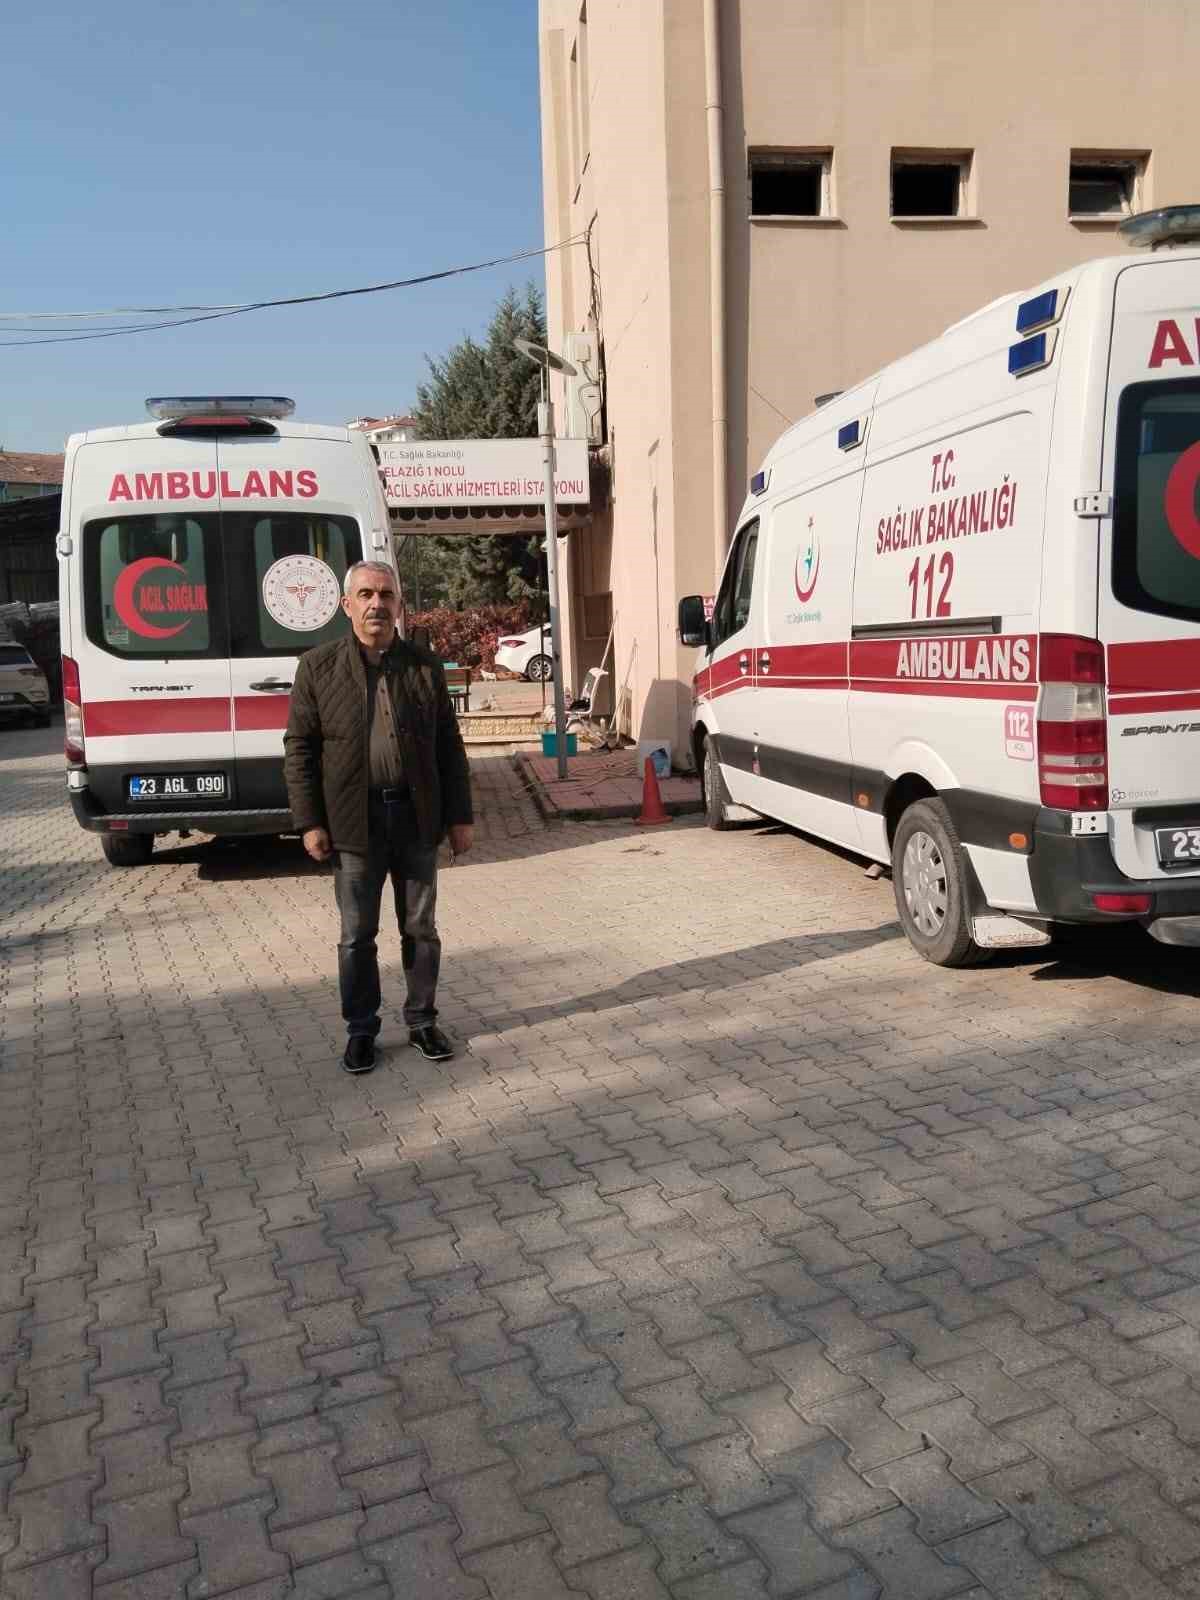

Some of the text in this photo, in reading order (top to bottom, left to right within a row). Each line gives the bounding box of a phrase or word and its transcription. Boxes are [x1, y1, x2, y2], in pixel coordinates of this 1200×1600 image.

[1148, 317, 1200, 368] A
[108, 470, 319, 502] AMBULANS
[384, 463, 465, 477] ELAZIĞ 1 NOLU
[386, 477, 584, 497] ACİL SAĞLIK HİZMETLERİ İSTAYONU
[931, 449, 956, 493] T.C.
[876, 474, 1017, 555] SAĞLIK BAKANLIĞI
[908, 551, 954, 619] 112
[896, 639, 1030, 681] AMBULANS
[1008, 711, 1030, 738] 112
[140, 776, 222, 793] 23 AGL 090
